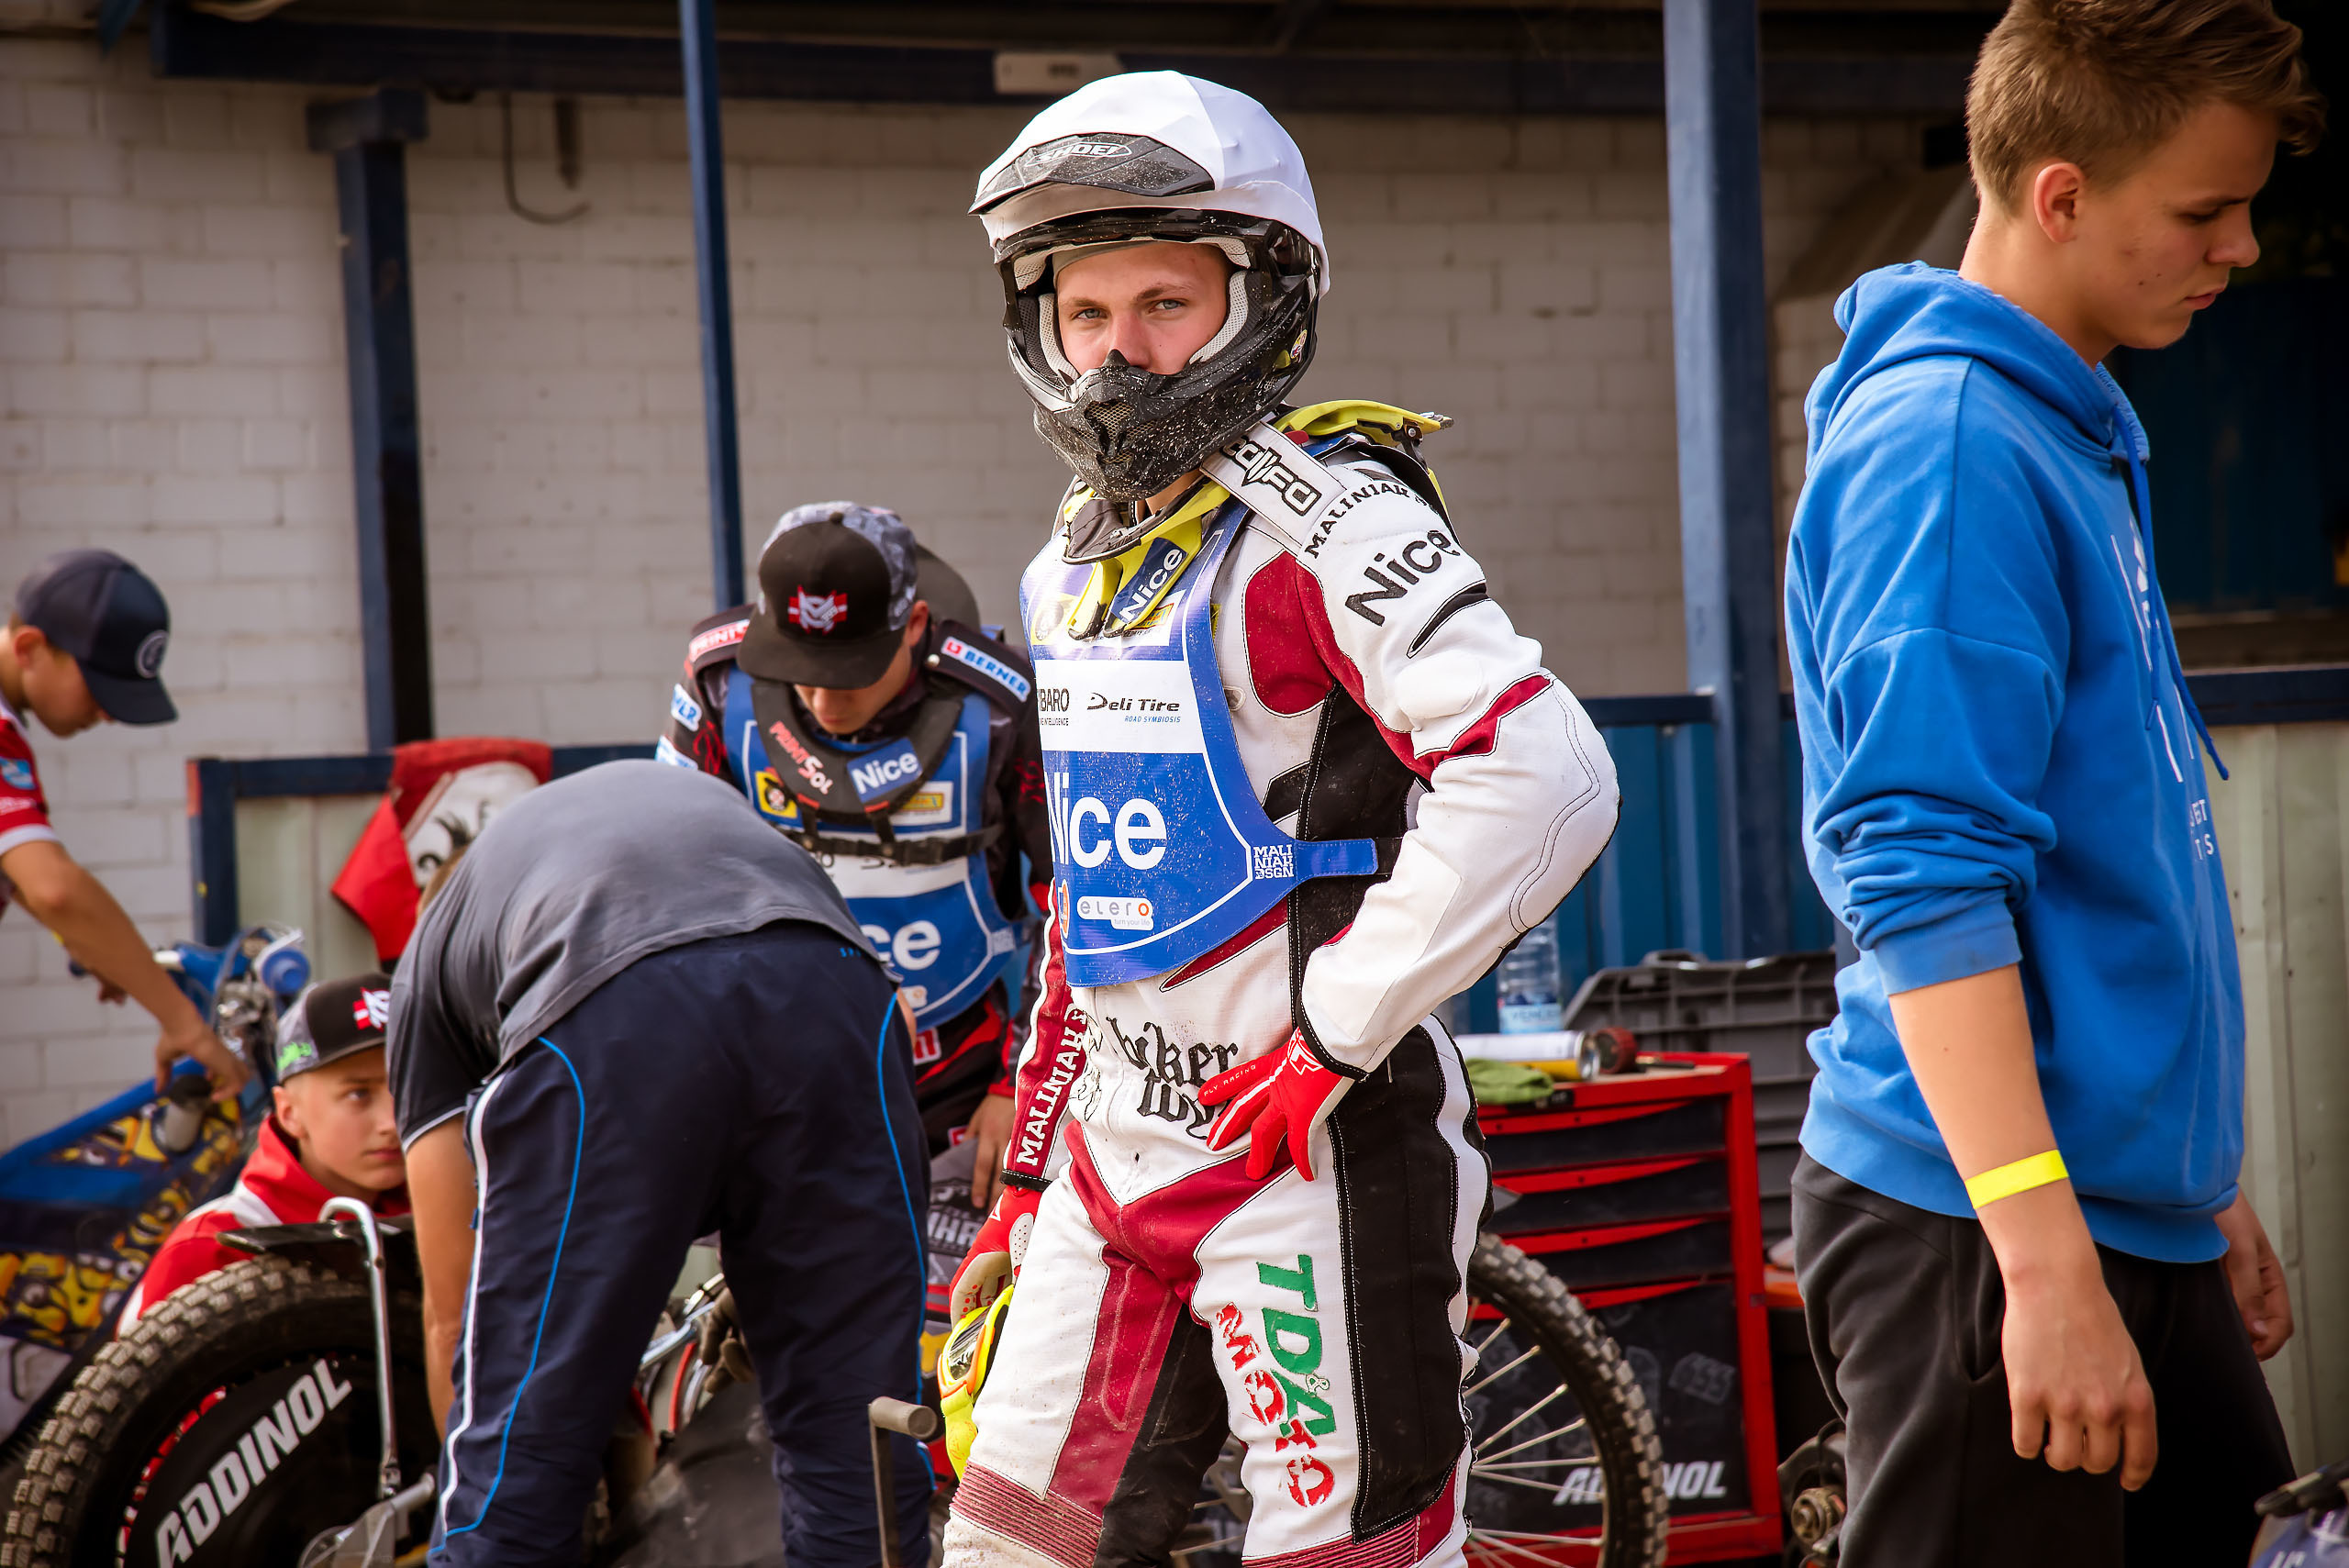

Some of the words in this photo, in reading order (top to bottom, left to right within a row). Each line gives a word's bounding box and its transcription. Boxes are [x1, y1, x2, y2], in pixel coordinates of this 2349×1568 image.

[1119, 549, 1184, 623] Nice
[1345, 529, 1461, 627] Nice
[964, 650, 1027, 695] BERNER
[1037, 688, 1070, 712] BARO
[1087, 692, 1132, 711] Deli
[1138, 698, 1180, 712] Tire
[1143, 716, 1181, 724] SYMBIOSIS
[851, 752, 918, 795] Nice
[1044, 772, 1168, 871] Nice
[1252, 843, 1293, 859] MALI
[1079, 900, 1150, 917] elero
[861, 919, 941, 971] ce
[1204, 1084, 1219, 1096] FLY
[1223, 1064, 1257, 1085] RACING
[156, 1358, 353, 1568] ADDINOL
[1553, 1462, 1727, 1506] ANOL
